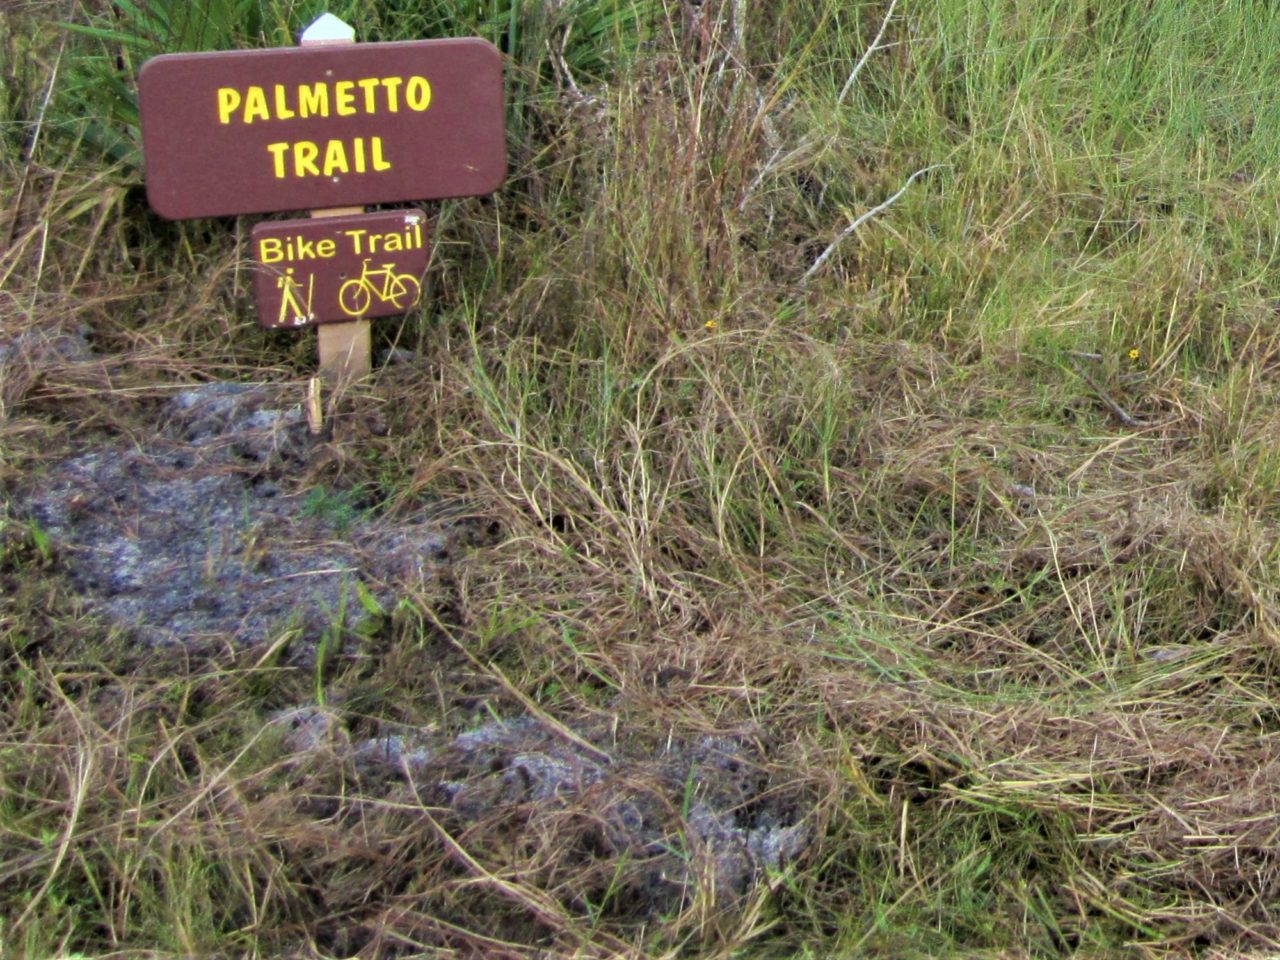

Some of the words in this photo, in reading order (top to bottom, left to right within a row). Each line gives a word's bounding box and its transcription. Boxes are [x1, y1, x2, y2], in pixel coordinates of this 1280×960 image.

[217, 76, 431, 124] PALMETTO
[267, 137, 391, 178] TRAIL
[259, 235, 336, 264] Bike
[345, 224, 422, 255] Trail
